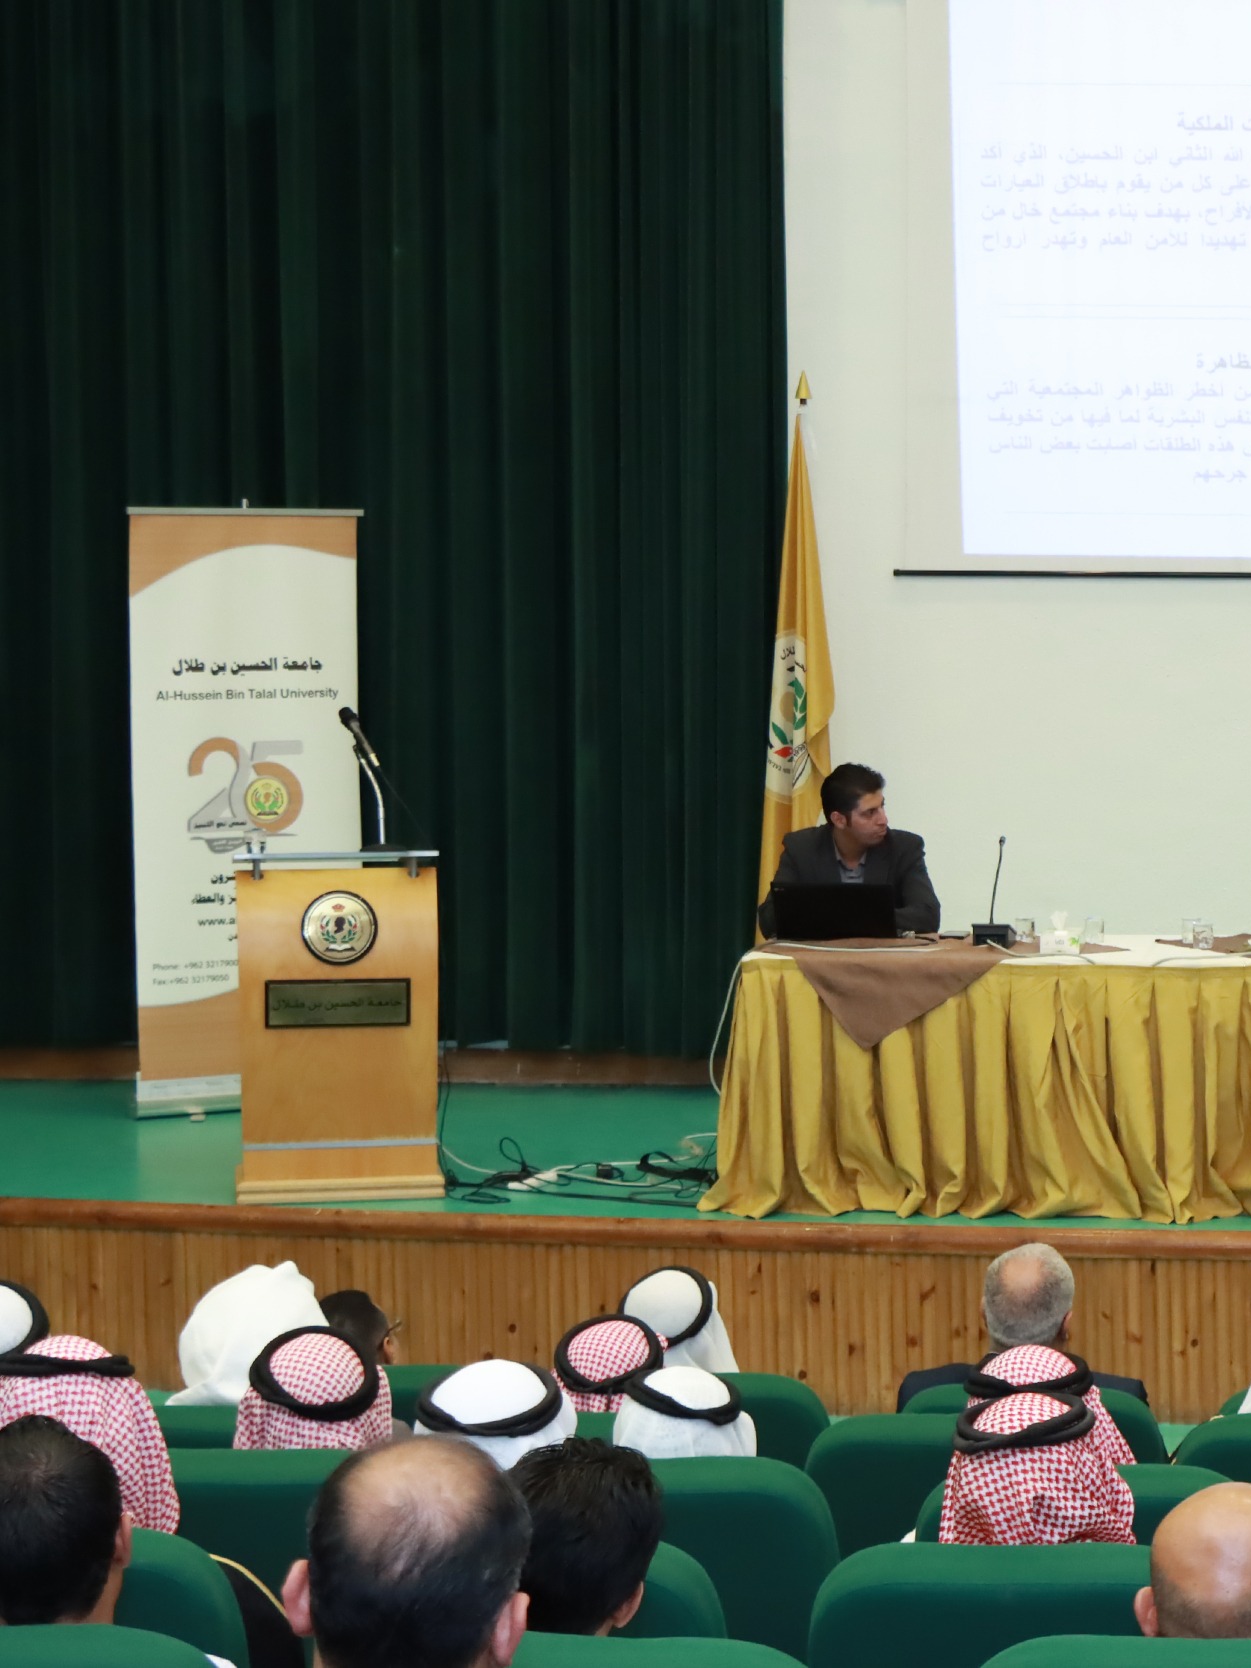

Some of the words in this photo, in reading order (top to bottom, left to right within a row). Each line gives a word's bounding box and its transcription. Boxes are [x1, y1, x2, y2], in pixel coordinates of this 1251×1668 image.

[1176, 111, 1233, 135] الملكية
[1013, 142, 1047, 164] الذي
[1134, 147, 1158, 164] ابن
[1168, 144, 1213, 166] الثاني
[1223, 147, 1243, 162] الله
[980, 172, 1044, 192] العيارات
[1116, 173, 1151, 193] يقوم
[1160, 175, 1183, 193] من
[1192, 174, 1212, 193] كل
[1220, 174, 1251, 196] على
[982, 203, 1006, 221] من
[1012, 201, 1042, 220] خال
[1049, 203, 1100, 224] مجتمع
[1107, 203, 1137, 221] بناء
[1144, 202, 1190, 222] بهدف
[1041, 231, 1088, 250] وتهدر
[1100, 230, 1132, 248] العام
[986, 380, 1018, 400] التي
[1028, 378, 1103, 400] المجتمعية
[1115, 381, 1173, 401] الظواهر
[987, 408, 1043, 427] تخويف
[1049, 409, 1074, 427] من
[1080, 407, 1111, 428] فيها
[1119, 408, 1140, 424] لما
[1147, 408, 1205, 428] البشرية
[988, 435, 1032, 453] الناس
[1039, 435, 1080, 454] بعض
[1143, 435, 1200, 453] الطلقات
[1208, 435, 1235, 453] هذه
[1192, 466, 1247, 484] جرحهم
[172, 658, 205, 677] طلال
[210, 661, 227, 676] بن
[230, 657, 278, 677] الحسين
[282, 656, 323, 674] جامعة
[156, 690, 222, 701] Al-Hussein
[226, 689, 245, 700] Bin
[248, 688, 277, 699] Talal
[280, 687, 339, 701] University
[187, 736, 304, 833] 25
[272, 999, 305, 1011] طلال
[308, 1001, 322, 1011] بن
[324, 997, 364, 1011] الحسين
[367, 996, 402, 1007] جامعة
